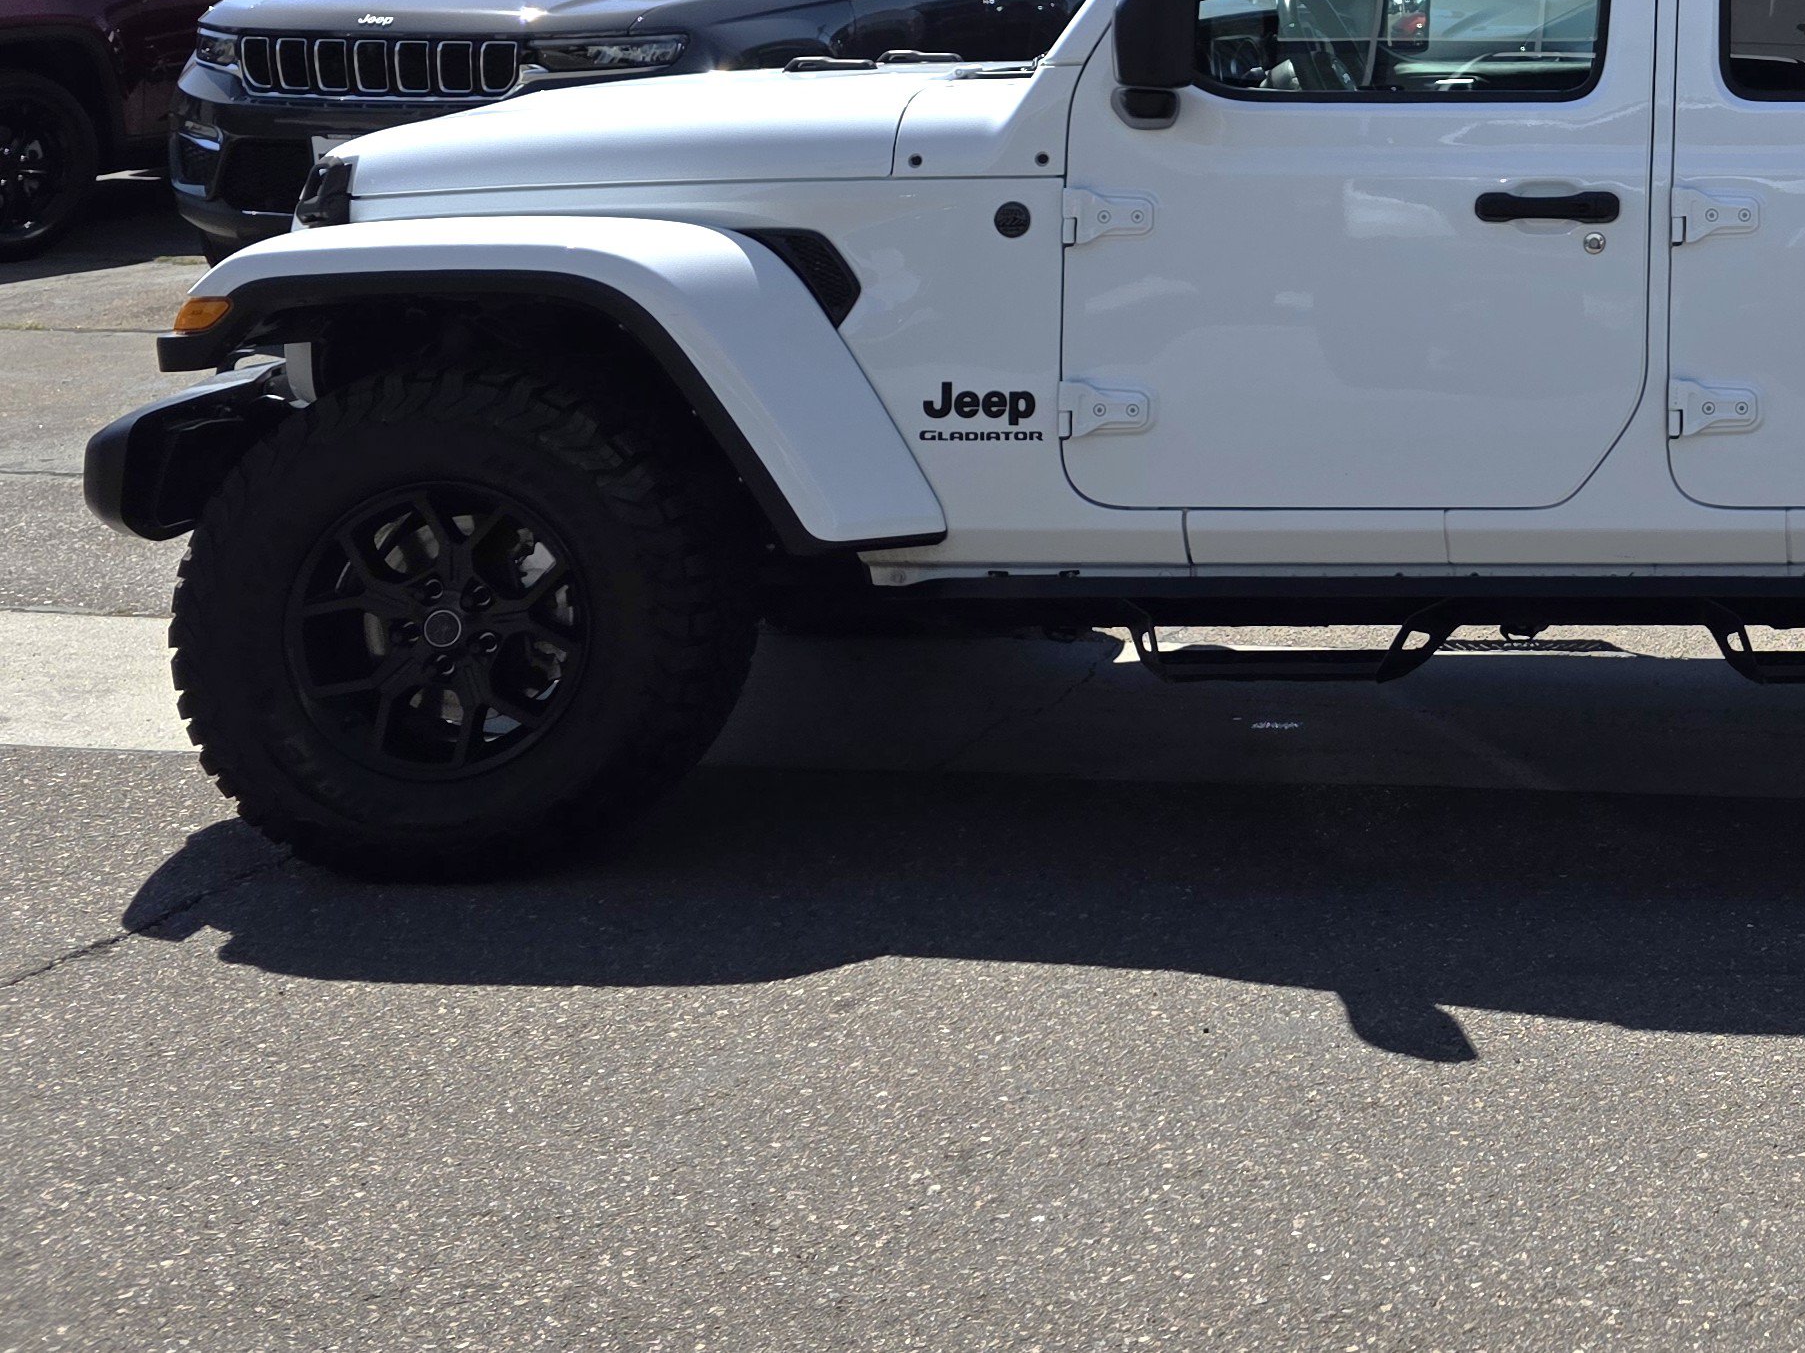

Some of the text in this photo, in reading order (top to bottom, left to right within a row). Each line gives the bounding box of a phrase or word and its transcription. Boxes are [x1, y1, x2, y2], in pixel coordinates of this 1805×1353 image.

[358, 13, 394, 26] Jeep
[923, 381, 1036, 426] Jeep
[919, 430, 1044, 442] GLADIATOR
